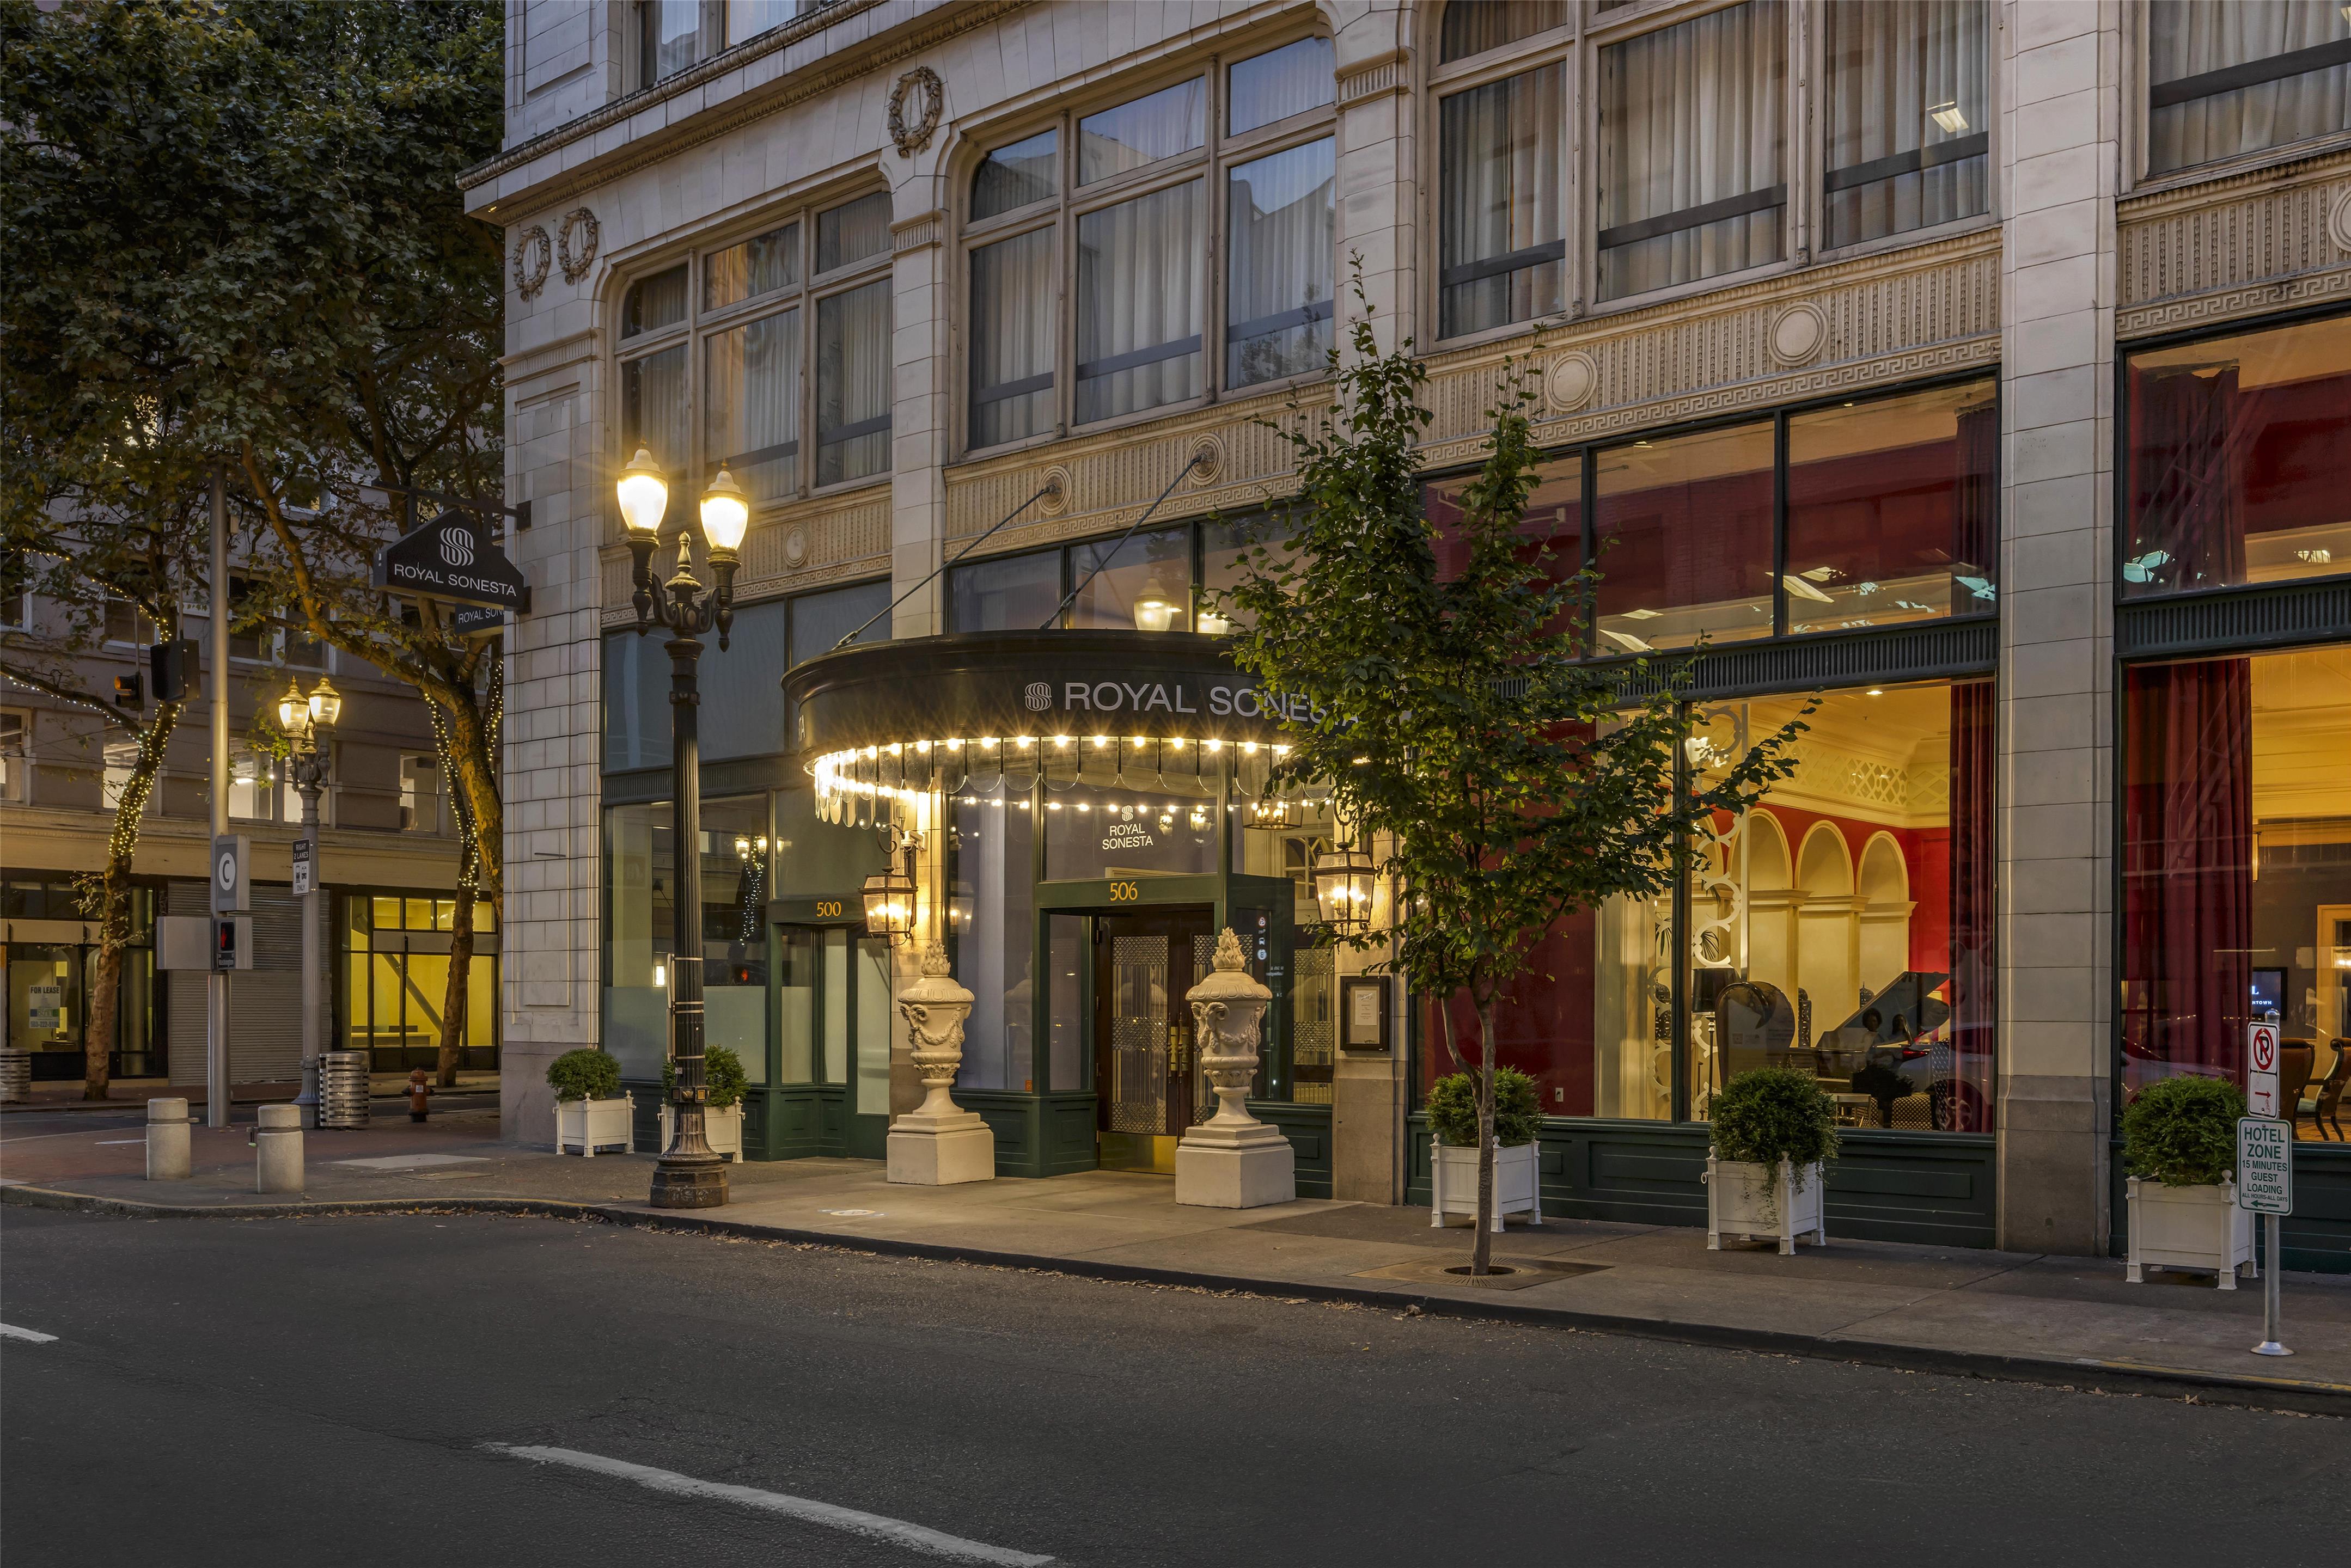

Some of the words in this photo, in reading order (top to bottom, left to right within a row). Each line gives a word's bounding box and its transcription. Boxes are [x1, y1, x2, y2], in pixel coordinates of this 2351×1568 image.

[394, 564, 444, 584] ROYAL
[448, 574, 516, 597] SONESTA
[459, 610, 484, 624] ROYAL
[485, 608, 504, 618] SON
[1065, 682, 1197, 714] ROYAL
[1209, 686, 1359, 727] SONES
[1109, 823, 1145, 836] ROYAL
[1102, 836, 1153, 850] SONESTA
[222, 860, 230, 883] C
[1109, 881, 1138, 901] 506
[816, 902, 841, 917] 500
[2244, 1126, 2285, 1143] HOTEL
[2247, 1144, 2281, 1159] ZONE
[2242, 1160, 2250, 1168] 15
[2252, 1160, 2287, 1172] MINUTES
[2251, 1172, 2278, 1183] GUEST
[2247, 1183, 2282, 1195] LOADING
